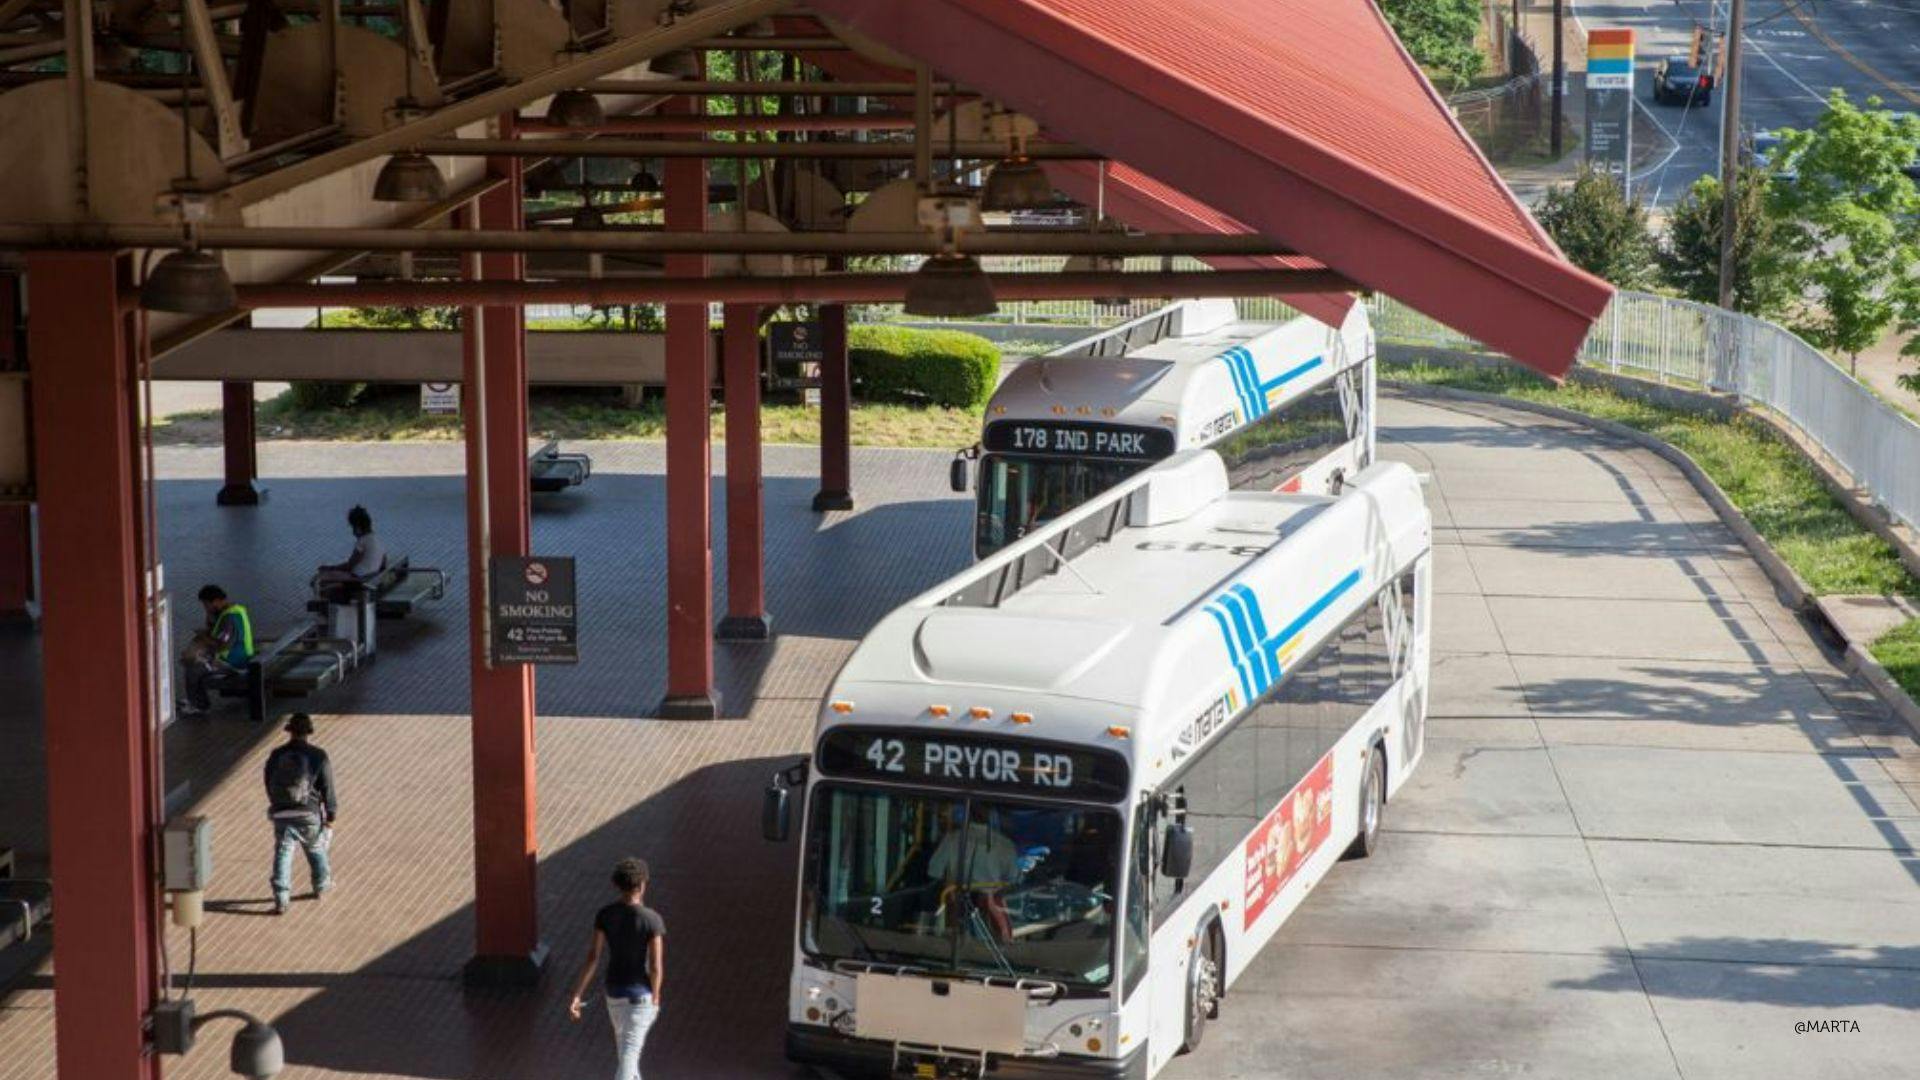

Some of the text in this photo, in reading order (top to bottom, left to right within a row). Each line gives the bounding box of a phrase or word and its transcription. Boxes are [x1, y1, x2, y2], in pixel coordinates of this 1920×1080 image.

[1014, 428, 1146, 454] 178 IND PARK
[526, 590, 549, 602] NO
[499, 604, 574, 618] SMOKING
[507, 627, 524, 641] 42
[866, 738, 1073, 787] 42 PRYOR RD
[871, 896, 883, 914] 2
